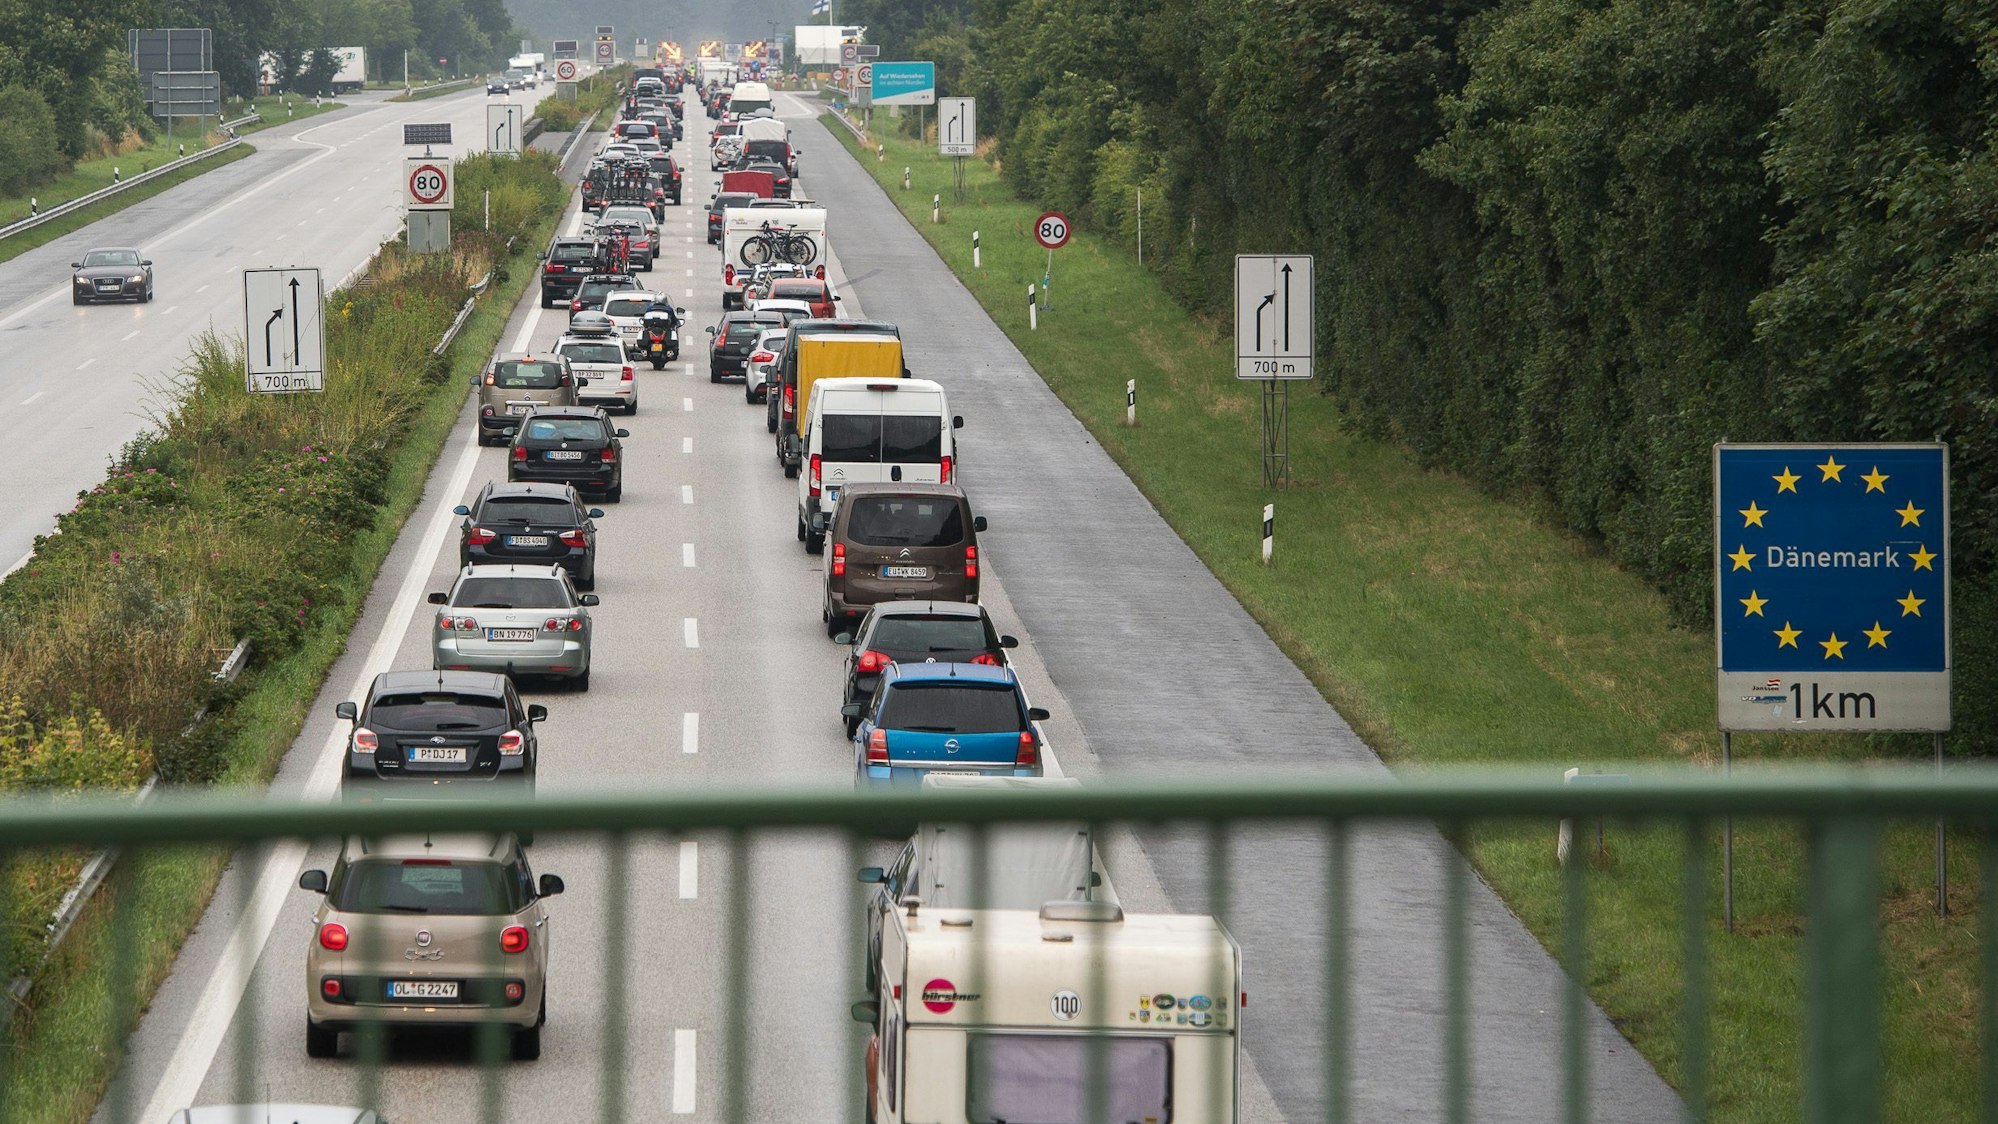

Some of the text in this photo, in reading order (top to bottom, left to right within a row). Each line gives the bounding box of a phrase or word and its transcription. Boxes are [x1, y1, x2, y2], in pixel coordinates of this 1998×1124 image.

[561, 66, 572, 74] 60
[417, 176, 440, 190] 80
[1041, 223, 1065, 239] 80
[1254, 361, 1295, 373] 700 m
[265, 376, 306, 388] 700 m
[1767, 546, 1900, 568] Dänemark
[494, 630, 532, 638] BN 19 776
[395, 984, 409, 995] OL
[428, 984, 456, 995] 2247
[1054, 996, 1078, 1014] 100
